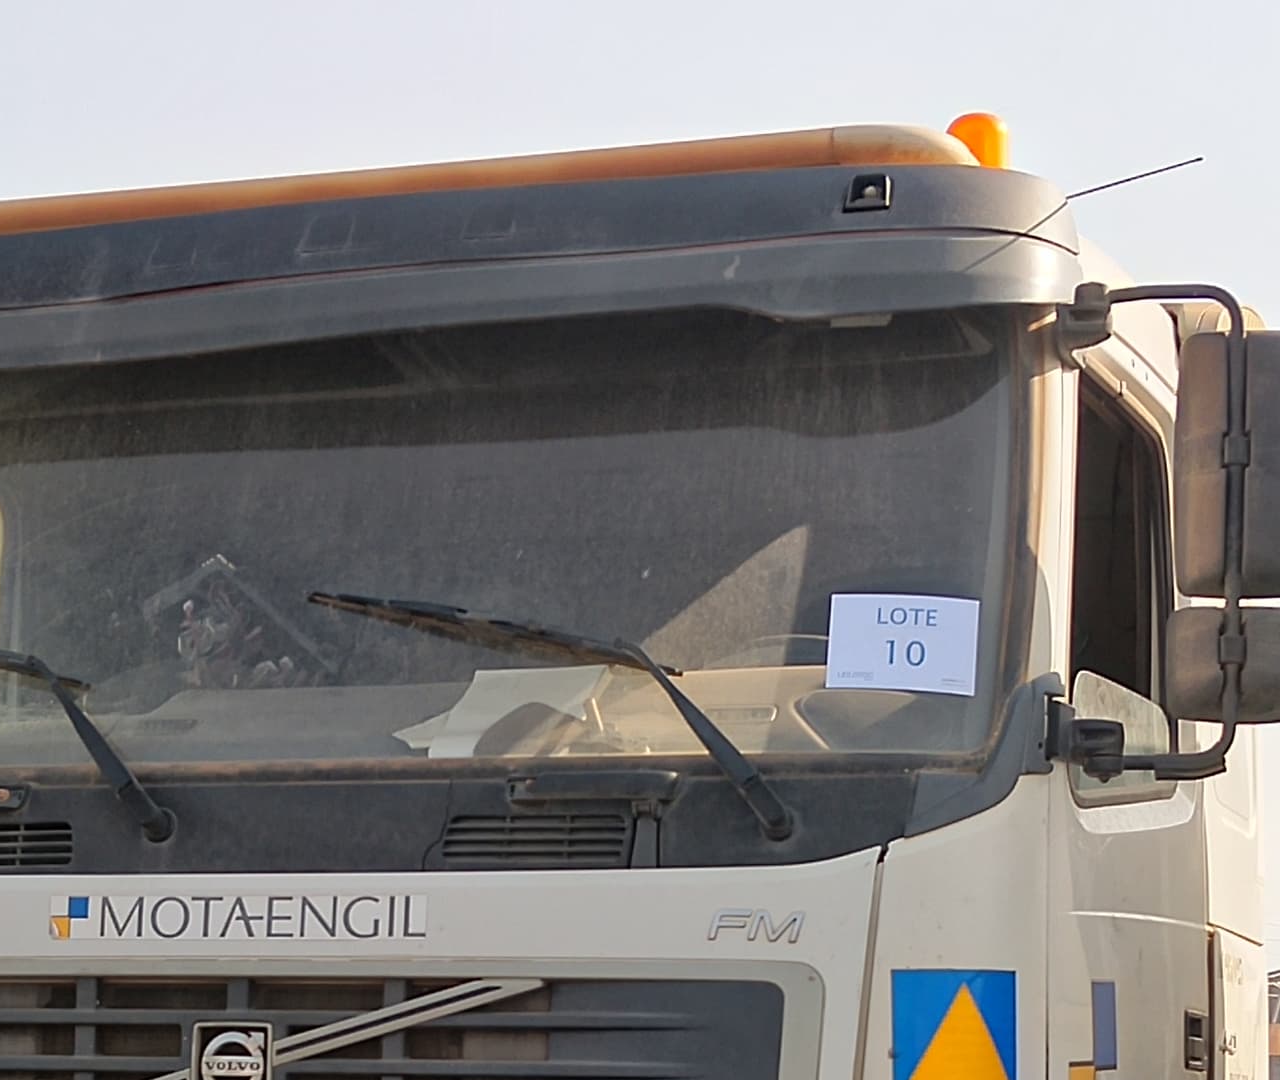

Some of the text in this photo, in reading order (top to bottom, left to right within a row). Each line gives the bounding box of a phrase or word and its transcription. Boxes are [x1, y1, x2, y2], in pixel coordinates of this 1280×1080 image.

[876, 607, 938, 627] LOTE
[885, 639, 926, 667] 10
[707, 908, 806, 944] FM
[205, 1061, 260, 1071] VOLVO
